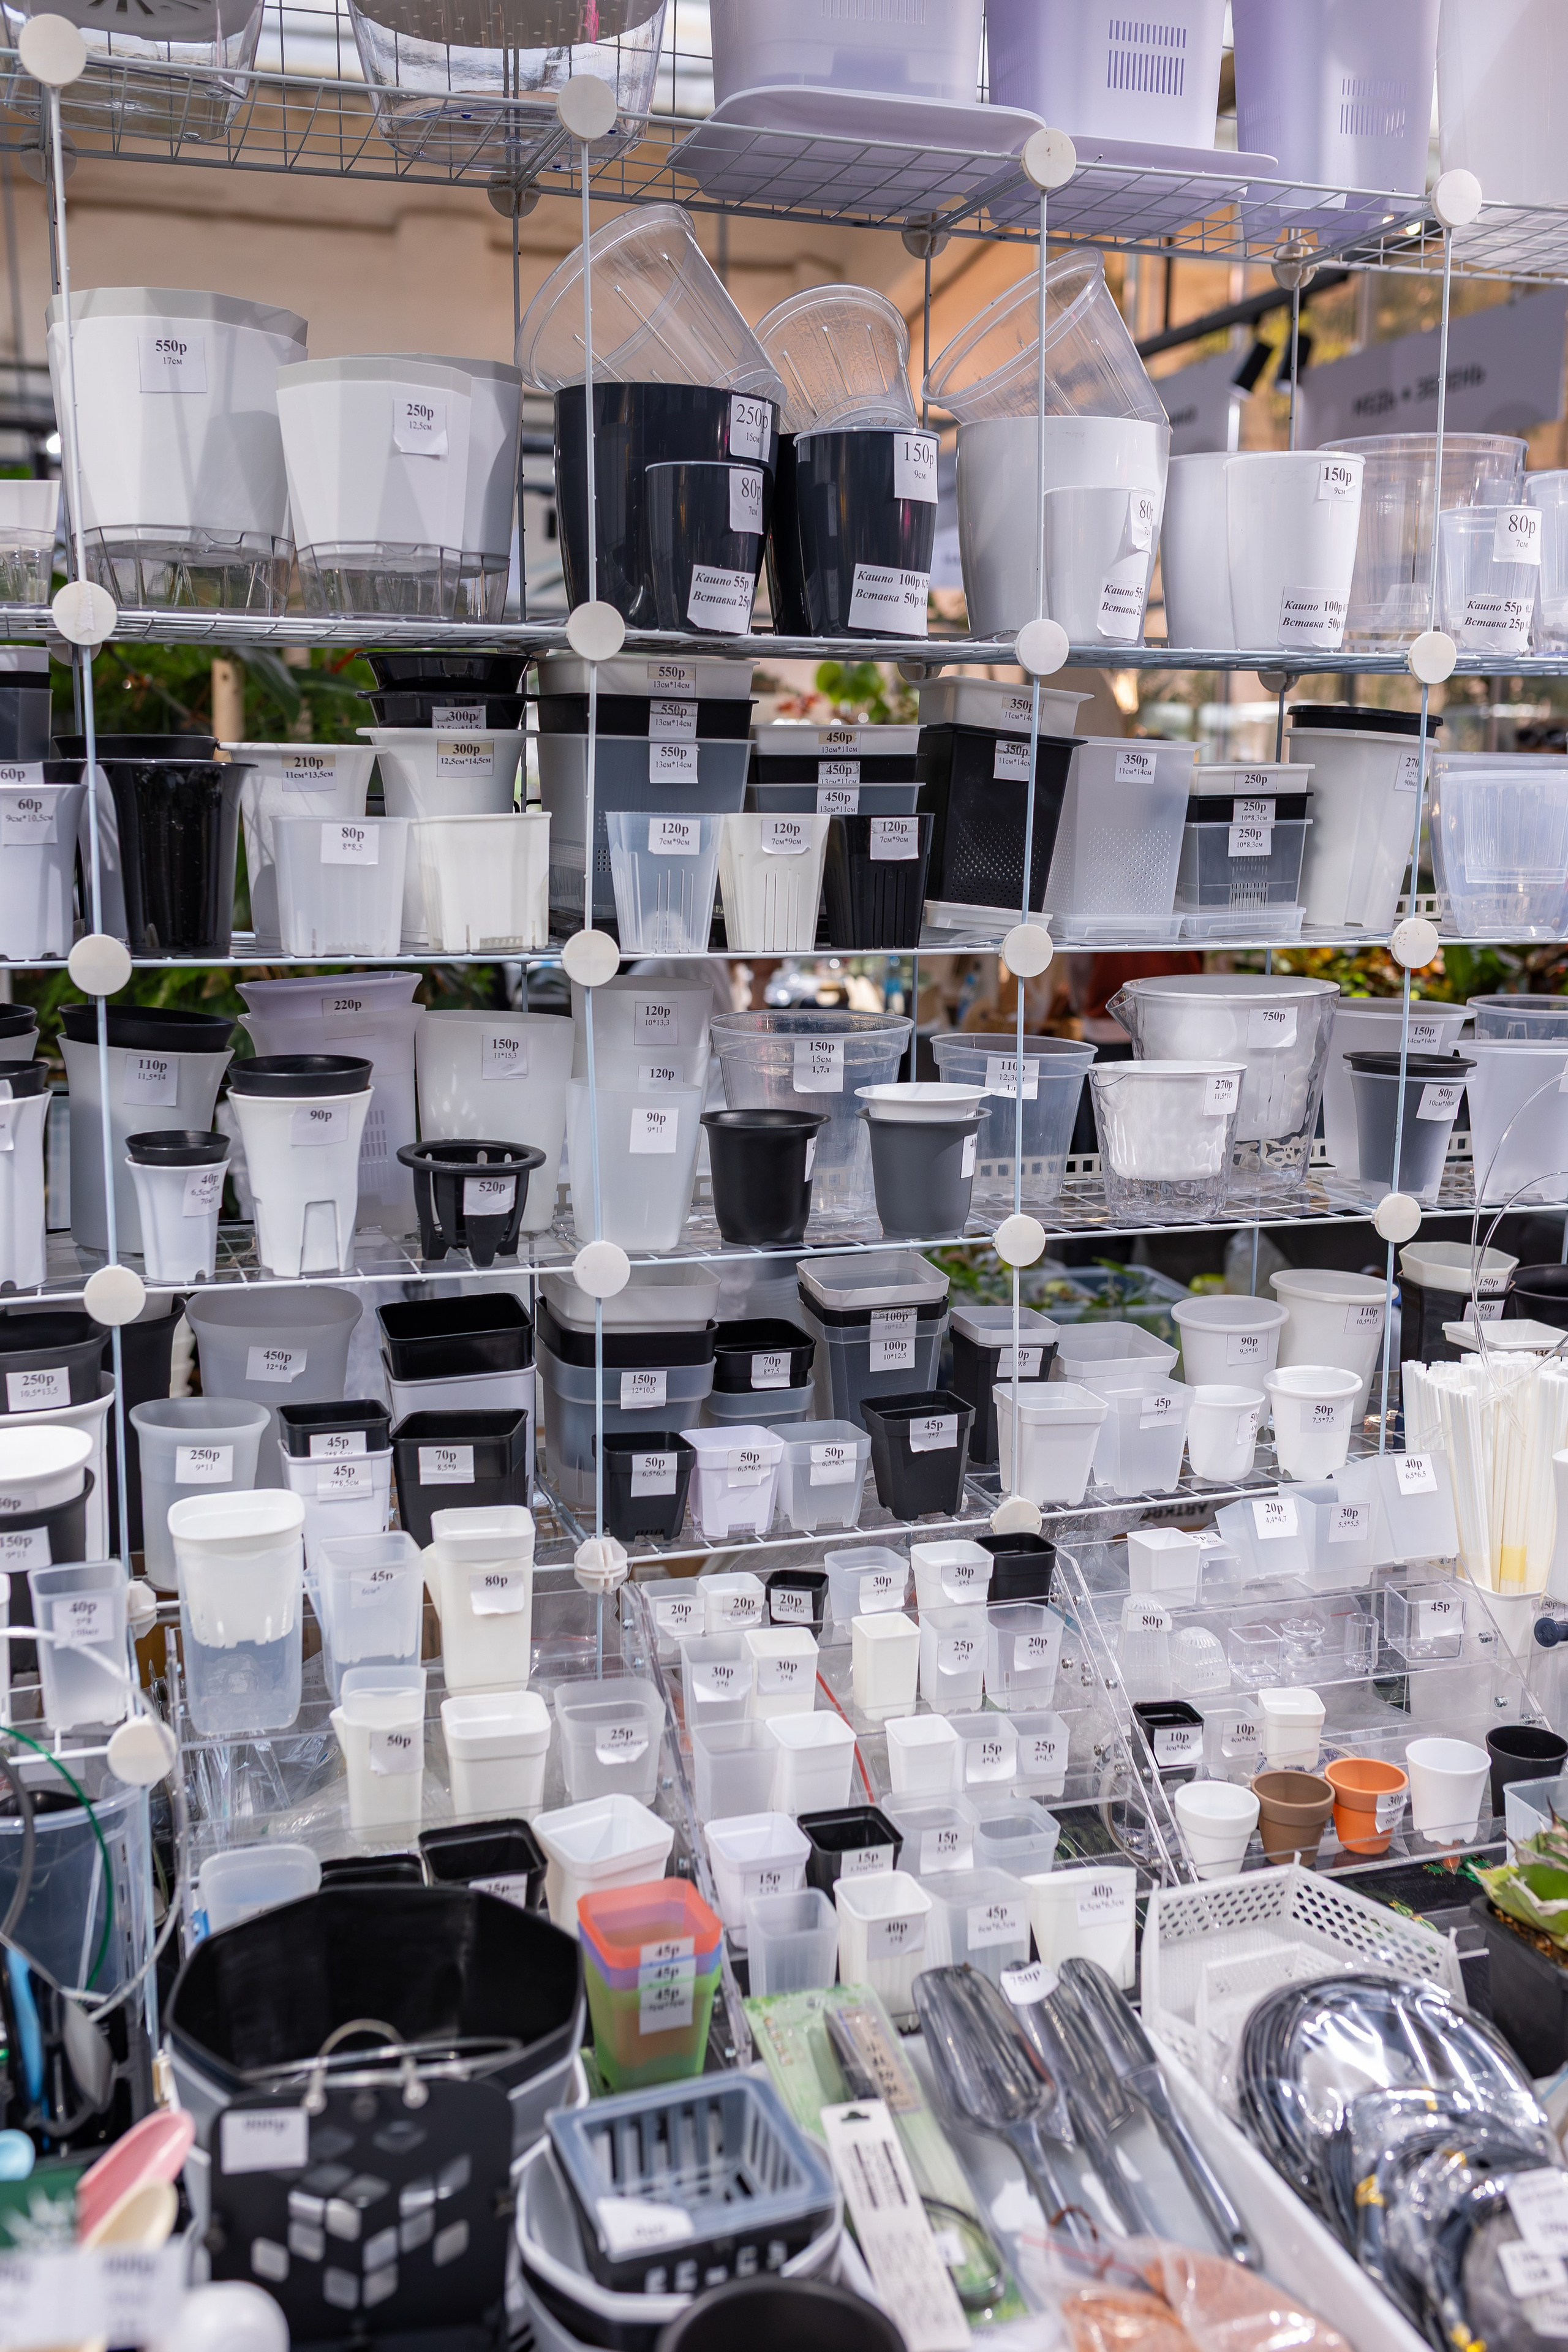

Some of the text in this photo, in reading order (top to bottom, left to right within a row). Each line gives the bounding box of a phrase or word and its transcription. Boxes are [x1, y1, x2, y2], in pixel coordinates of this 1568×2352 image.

[155, 340, 187, 355] 550р
[407, 404, 434, 418] 250р
[409, 421, 432, 430] 12,5см
[736, 404, 769, 435] 250р
[746, 432, 760, 443] 15см
[903, 441, 934, 467] 150р
[914, 469, 926, 480] 9см
[1324, 467, 1352, 485] 150р
[741, 477, 761, 505] 80р
[1334, 486, 1346, 495] 9см
[1508, 514, 1536, 539] 80р
[1516, 539, 1528, 548] 7см
[695, 571, 750, 591] Кашпо 55р
[856, 570, 921, 590] Кашпо 100р
[1104, 584, 1134, 598] Кашпо
[693, 591, 737, 607] Вставка
[854, 589, 919, 608] Вставка 50р
[1102, 601, 1137, 616] Вставка
[1284, 600, 1343, 614] Кашпо 100р
[1466, 600, 1523, 614] Кашпо 55р
[1282, 614, 1342, 631] Вставка 50р
[1464, 616, 1525, 631] Вставка 25р
[658, 666, 685, 680] 550р
[448, 710, 477, 723] 300р
[661, 704, 687, 718] 550р
[826, 731, 853, 744] 450р
[453, 744, 480, 756] 300р
[660, 746, 687, 760] 550р
[1005, 744, 1028, 758] 350р
[294, 756, 323, 770] 210р
[1124, 754, 1148, 768] 350р
[1, 768, 25, 782] 60р
[826, 762, 853, 777] 450р
[1244, 774, 1268, 786] 250р
[825, 791, 851, 804] 450р
[18, 798, 42, 813] 60р
[1243, 801, 1267, 813] 250р
[662, 823, 689, 836] 120р
[774, 822, 801, 836] 120р
[881, 821, 908, 834] 120р
[341, 827, 365, 842] 80р
[1238, 828, 1262, 841] 250р
[334, 1000, 362, 1011] 220р
[645, 1006, 671, 1018] 120р
[1262, 1011, 1286, 1023] 750р
[1414, 1026, 1434, 1038] 150р
[492, 1039, 519, 1052] 150р
[809, 1041, 835, 1054] 150р
[138, 1060, 167, 1072] 110р
[812, 1066, 830, 1074] 1,7л
[649, 1068, 674, 1080] 120р
[1215, 1080, 1233, 1091] 270р
[1438, 1088, 1453, 1098] 80р
[310, 1110, 333, 1123] 90р
[647, 1112, 666, 1123] 90р
[200, 1173, 219, 1186] 40р
[479, 1181, 505, 1194] 520р
[1479, 1278, 1499, 1289] 150р
[884, 1311, 909, 1324] 100р
[1360, 1307, 1378, 1319] 110р
[883, 1341, 907, 1352] 100р
[1241, 1336, 1259, 1348] 90р
[263, 1350, 292, 1363] 450р
[763, 1355, 782, 1367] 70р
[22, 1374, 54, 1387] 250р
[632, 1374, 657, 1386] 150р
[1154, 1397, 1171, 1409] 45р
[1314, 1404, 1333, 1417] 50р
[924, 1420, 943, 1432] 45р
[327, 1436, 349, 1449] 45р
[190, 1450, 221, 1463] 250р
[435, 1449, 456, 1461] 70р
[740, 1451, 760, 1464] 50р
[824, 1446, 844, 1458] 50р
[645, 1457, 665, 1469] 50р
[1405, 1458, 1423, 1470] 40р
[333, 1465, 355, 1478] 45р
[1264, 1502, 1283, 1515] 20р
[1340, 1508, 1359, 1520] 30р
[955, 1567, 974, 1580] 30р
[484, 1574, 508, 1588] 80р
[873, 1575, 892, 1588] 30р
[733, 1597, 755, 1610] 20р
[780, 1593, 802, 1606] 20р
[671, 1604, 692, 1616] 20р
[1431, 1601, 1450, 1613] 45р
[1142, 1615, 1163, 1629] 80р
[953, 1640, 974, 1653] 25р
[1028, 1636, 1047, 1648] 20р
[712, 1665, 734, 1679] 30р
[775, 1660, 798, 1673] 30р
[611, 1727, 633, 1741] 25р
[1236, 1723, 1255, 1736] 10р
[387, 1734, 412, 1749] 50р
[1170, 1732, 1189, 1744] 10р
[982, 1743, 1002, 1755] 15р
[1035, 1741, 1055, 1754] 25р
[938, 1831, 958, 1844] 15р
[760, 1872, 780, 1885] 15р
[1091, 1885, 1113, 1899] 40р
[986, 1907, 1008, 1921] 45р
[885, 1921, 908, 1935] 40р
